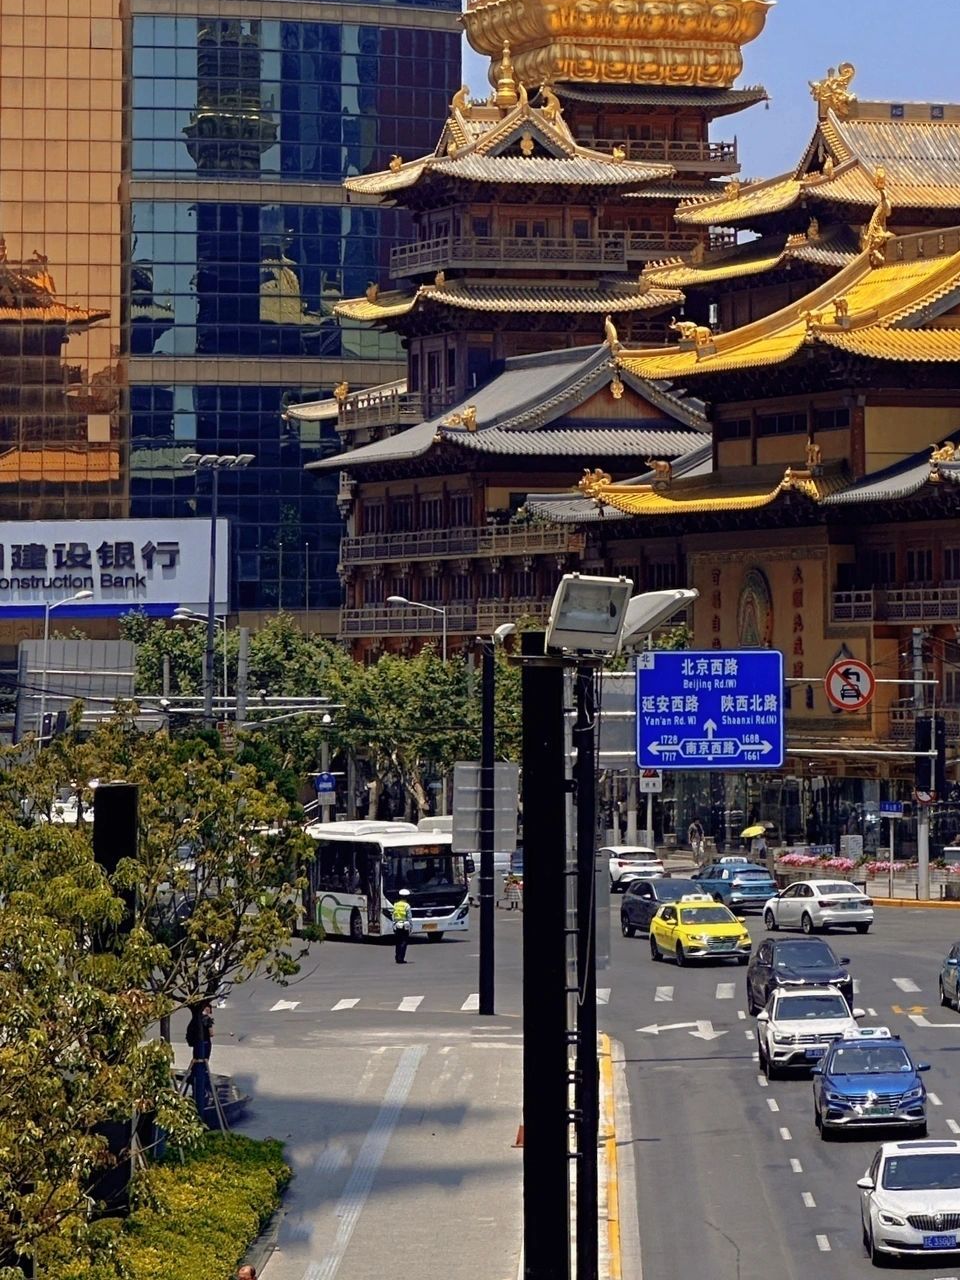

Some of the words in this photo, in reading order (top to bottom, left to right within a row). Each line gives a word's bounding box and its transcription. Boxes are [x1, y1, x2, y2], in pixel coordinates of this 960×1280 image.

[0, 541, 179, 570] 建设银行
[101, 573, 146, 588] Bank
[681, 658, 738, 676] 北京西路
[683, 679, 712, 691] Beijing
[714, 679, 737, 689] Rd.(W)
[642, 695, 699, 713] 延安西路
[721, 694, 778, 712] 陕西北路
[644, 716, 672, 726] Yan'an
[674, 715, 697, 726] Rd.W)
[722, 715, 754, 725] Shaanxi
[660, 735, 678, 744] 1728
[742, 734, 760, 744] 1688
[685, 741, 735, 755] 南京西路
[661, 752, 677, 761] 1717
[744, 751, 760, 760] 1661
